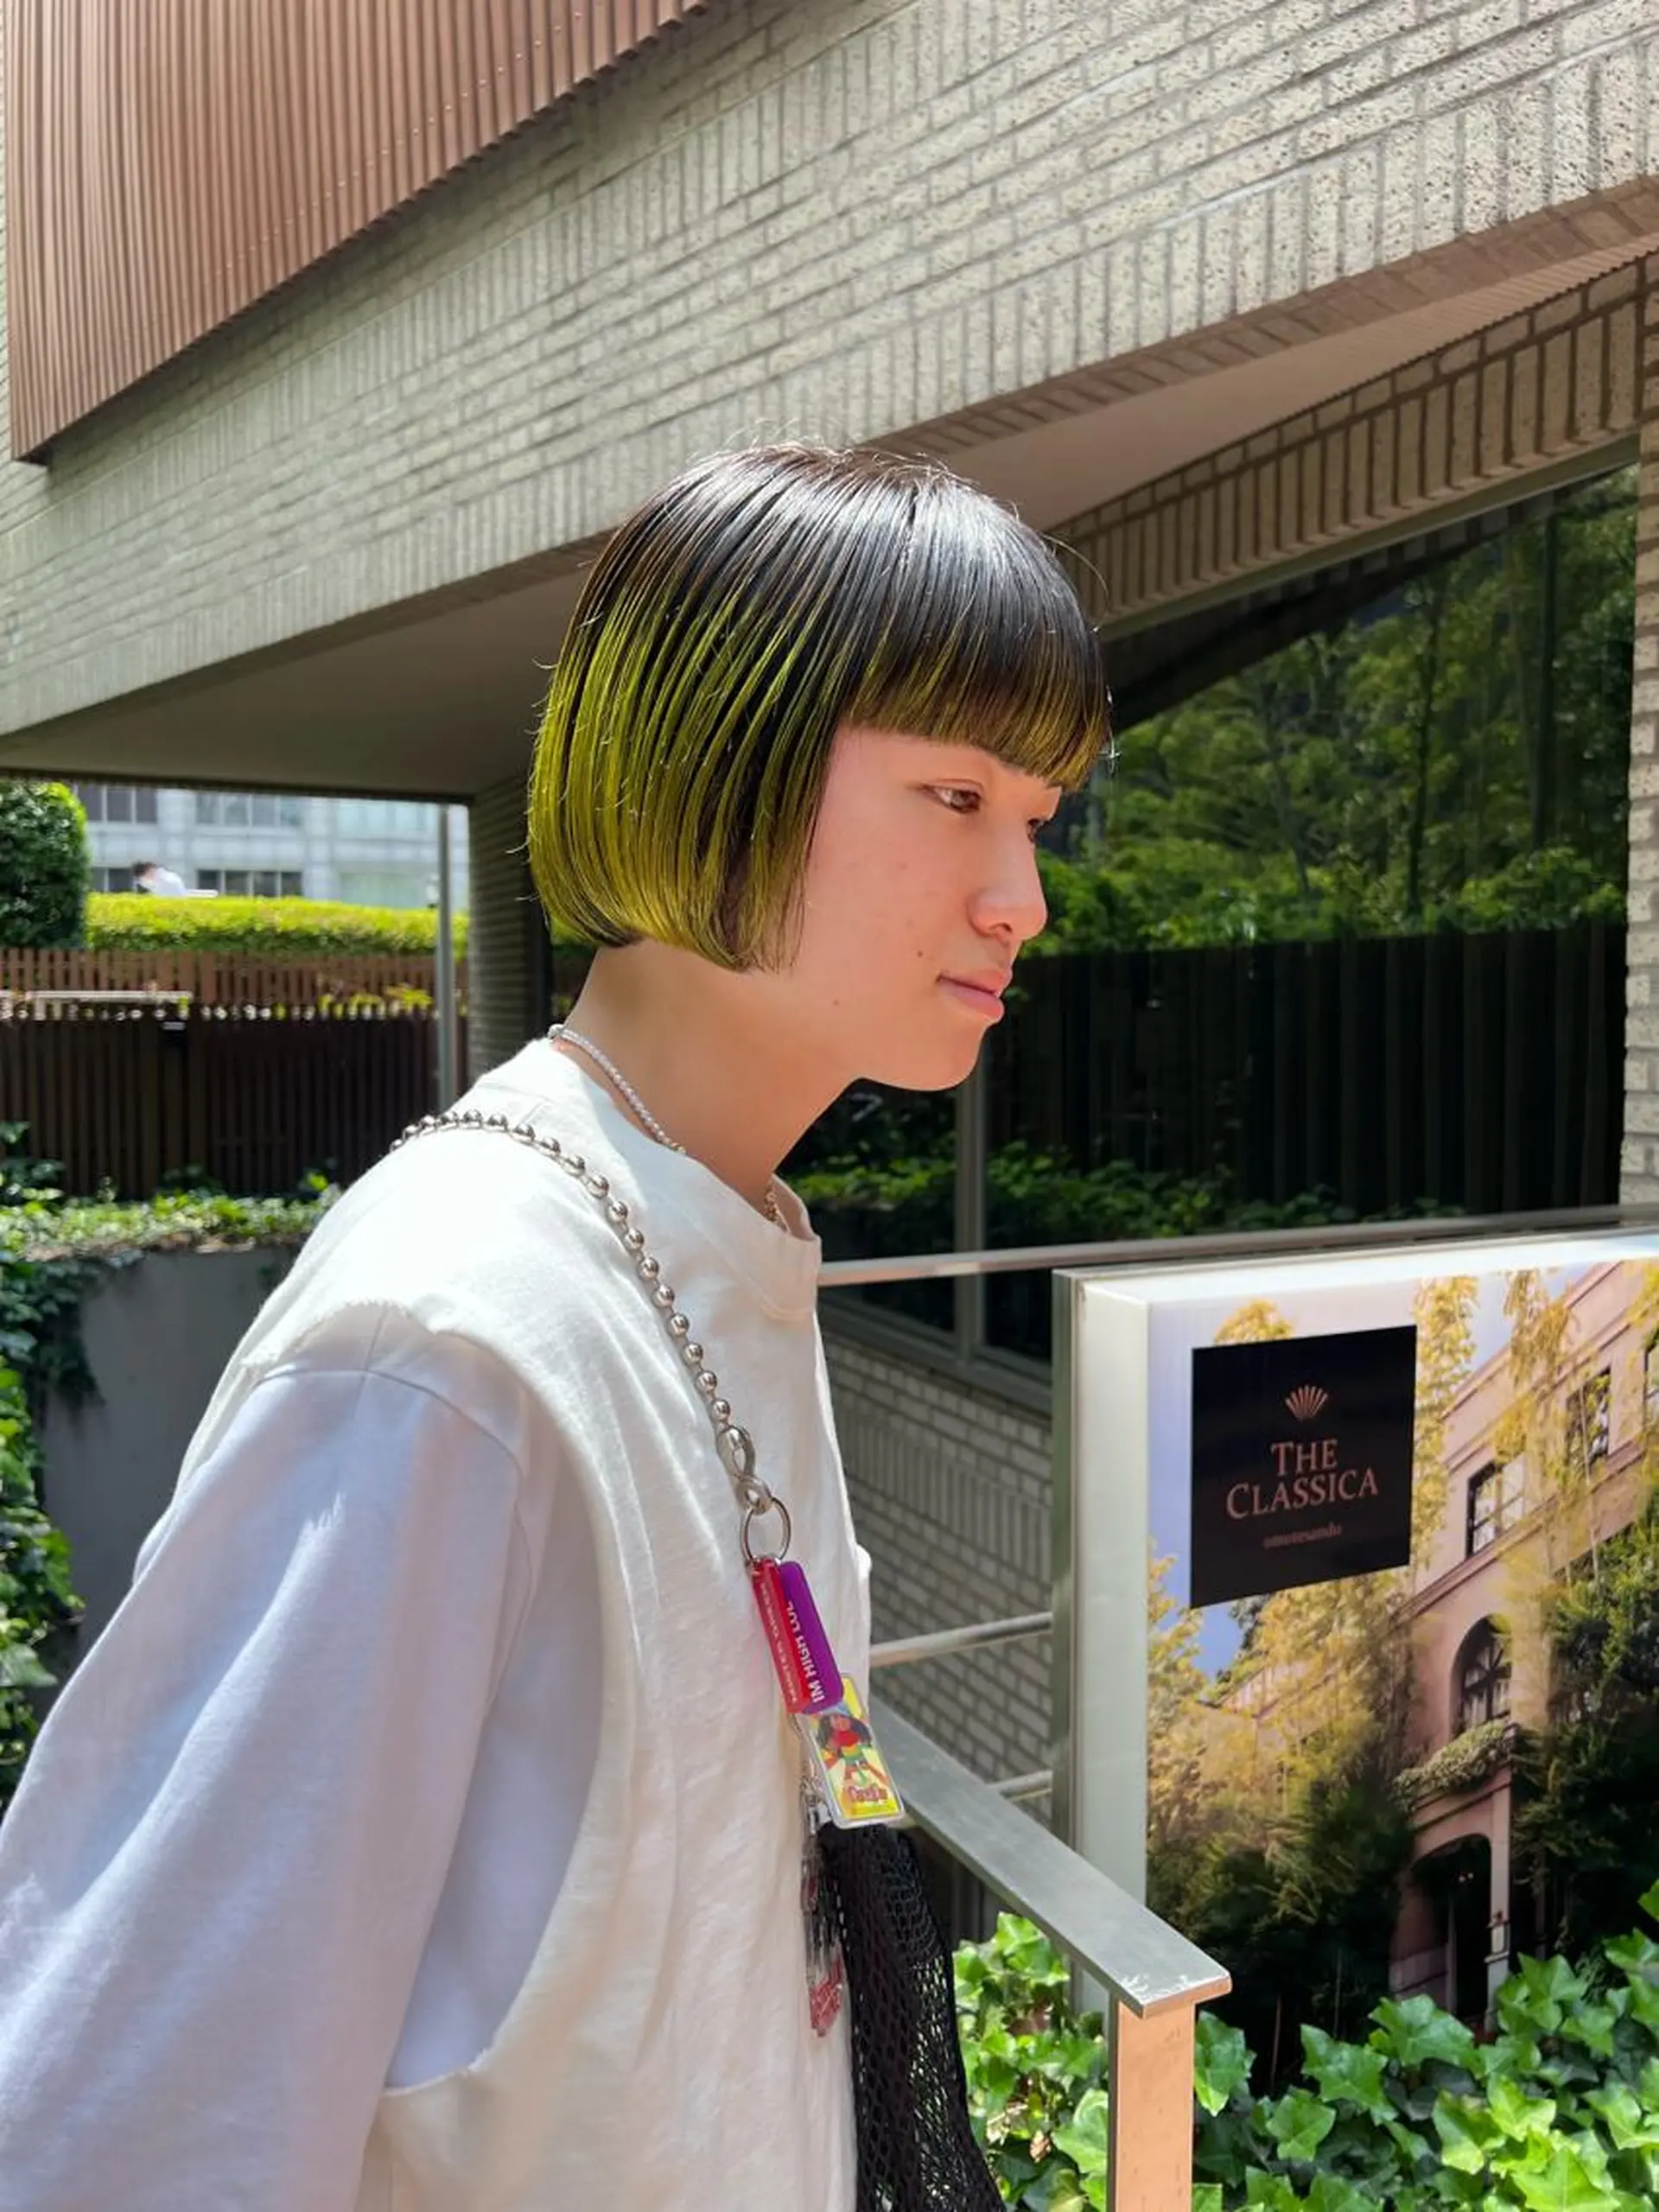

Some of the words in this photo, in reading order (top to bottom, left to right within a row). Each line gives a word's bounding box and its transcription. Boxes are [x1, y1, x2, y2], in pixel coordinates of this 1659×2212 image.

[1270, 1438, 1338, 1477] THE
[1226, 1467, 1380, 1519] CLASSICA
[794, 1635, 817, 1678] HIGH
[808, 1679, 825, 1703] IM
